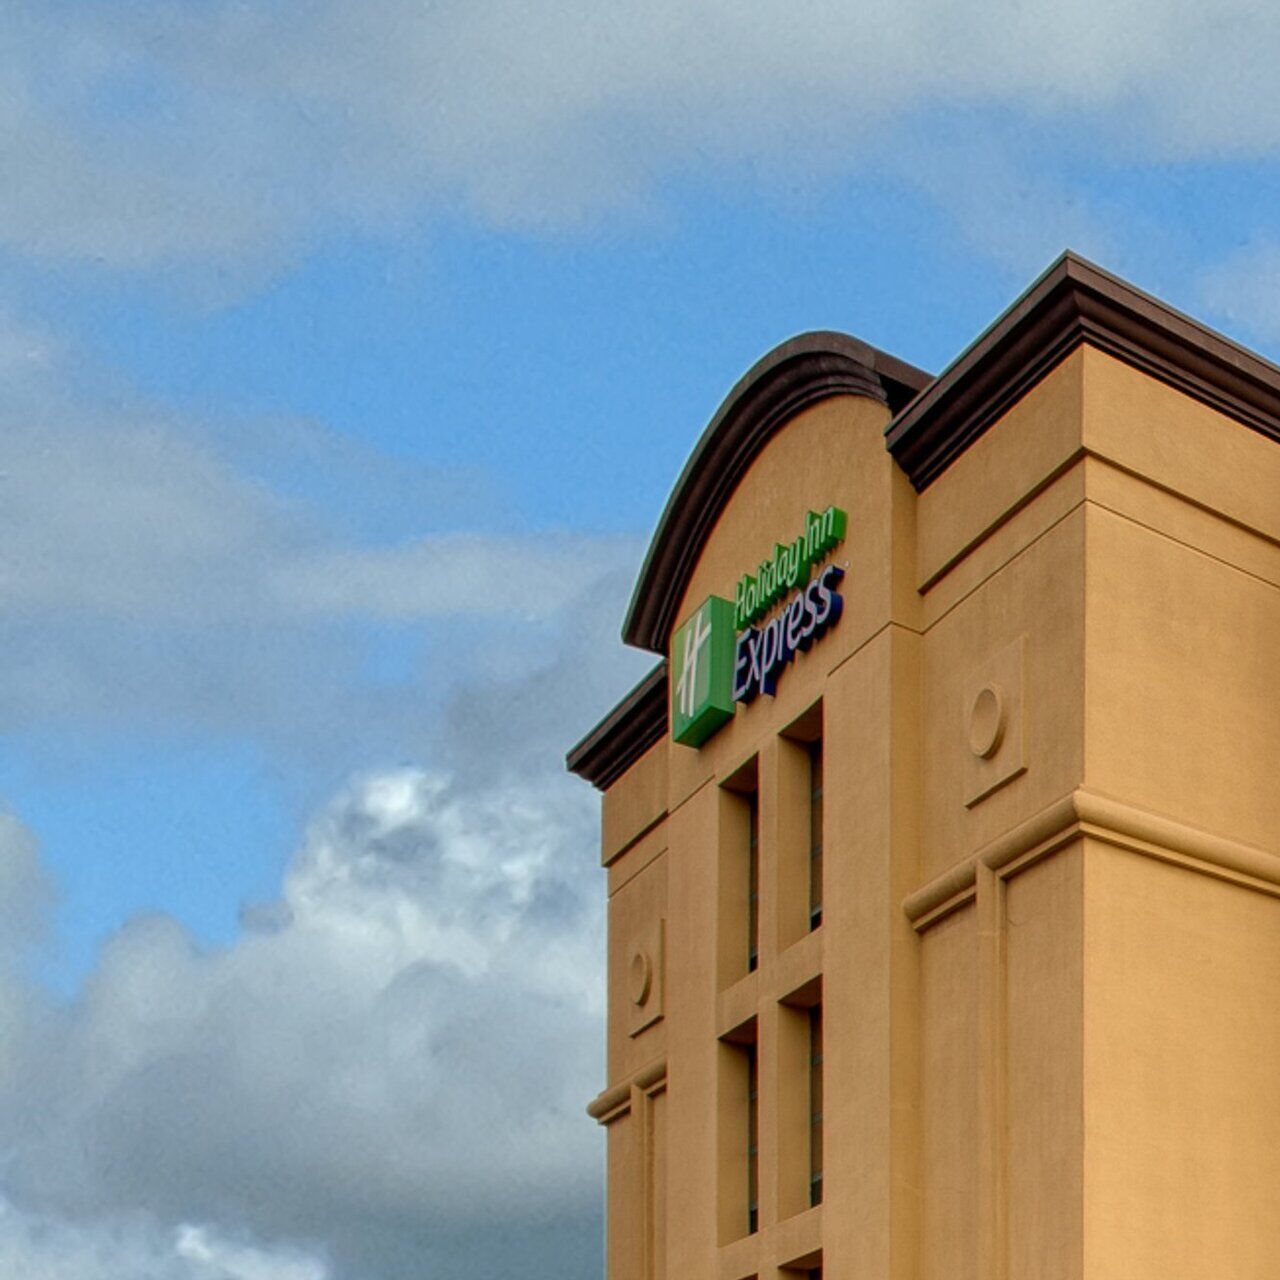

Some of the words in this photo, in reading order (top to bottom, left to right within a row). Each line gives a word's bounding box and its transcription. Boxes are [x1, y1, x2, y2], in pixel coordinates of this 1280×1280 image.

[734, 537, 806, 624] Holiday
[803, 505, 842, 561] Inn
[732, 565, 840, 701] Express
